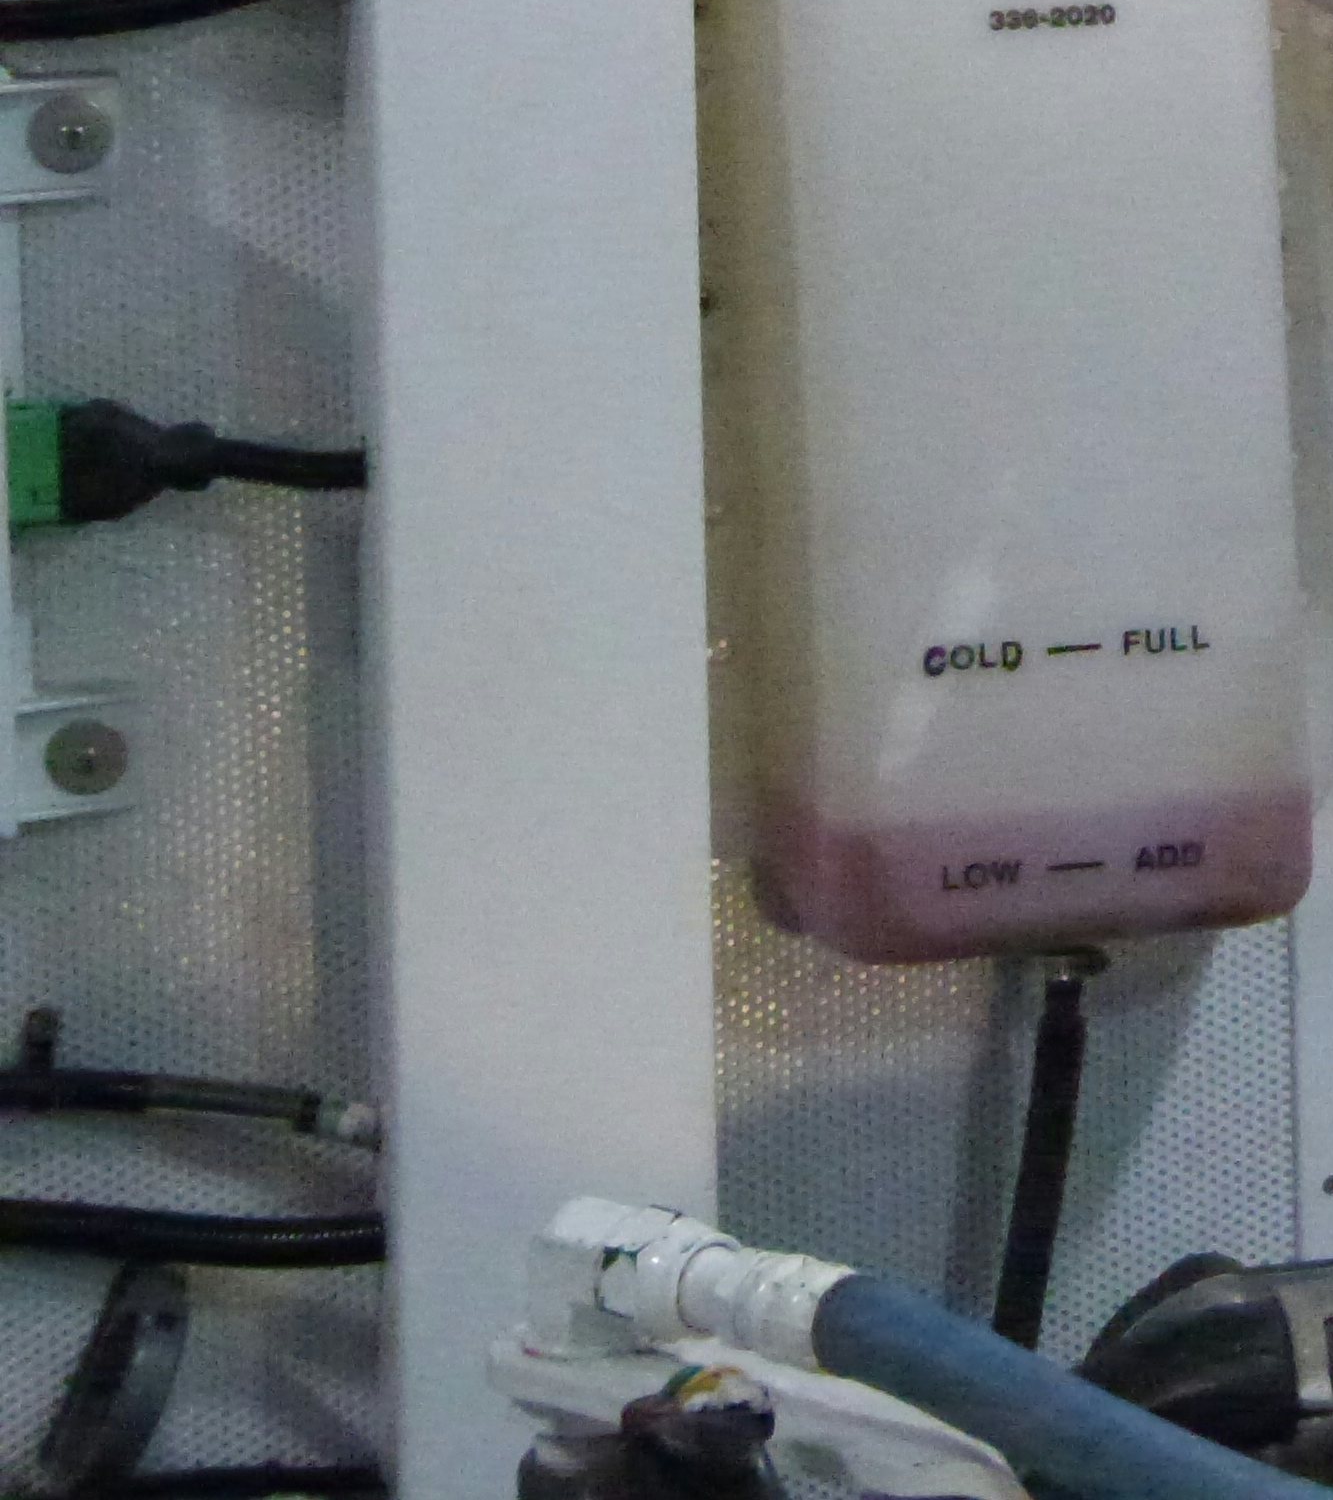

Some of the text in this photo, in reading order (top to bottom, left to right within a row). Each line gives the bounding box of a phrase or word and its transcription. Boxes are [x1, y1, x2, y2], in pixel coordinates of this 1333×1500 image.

[922, 624, 1211, 678] COLD FULL
[942, 840, 1207, 891] LOW ADD
